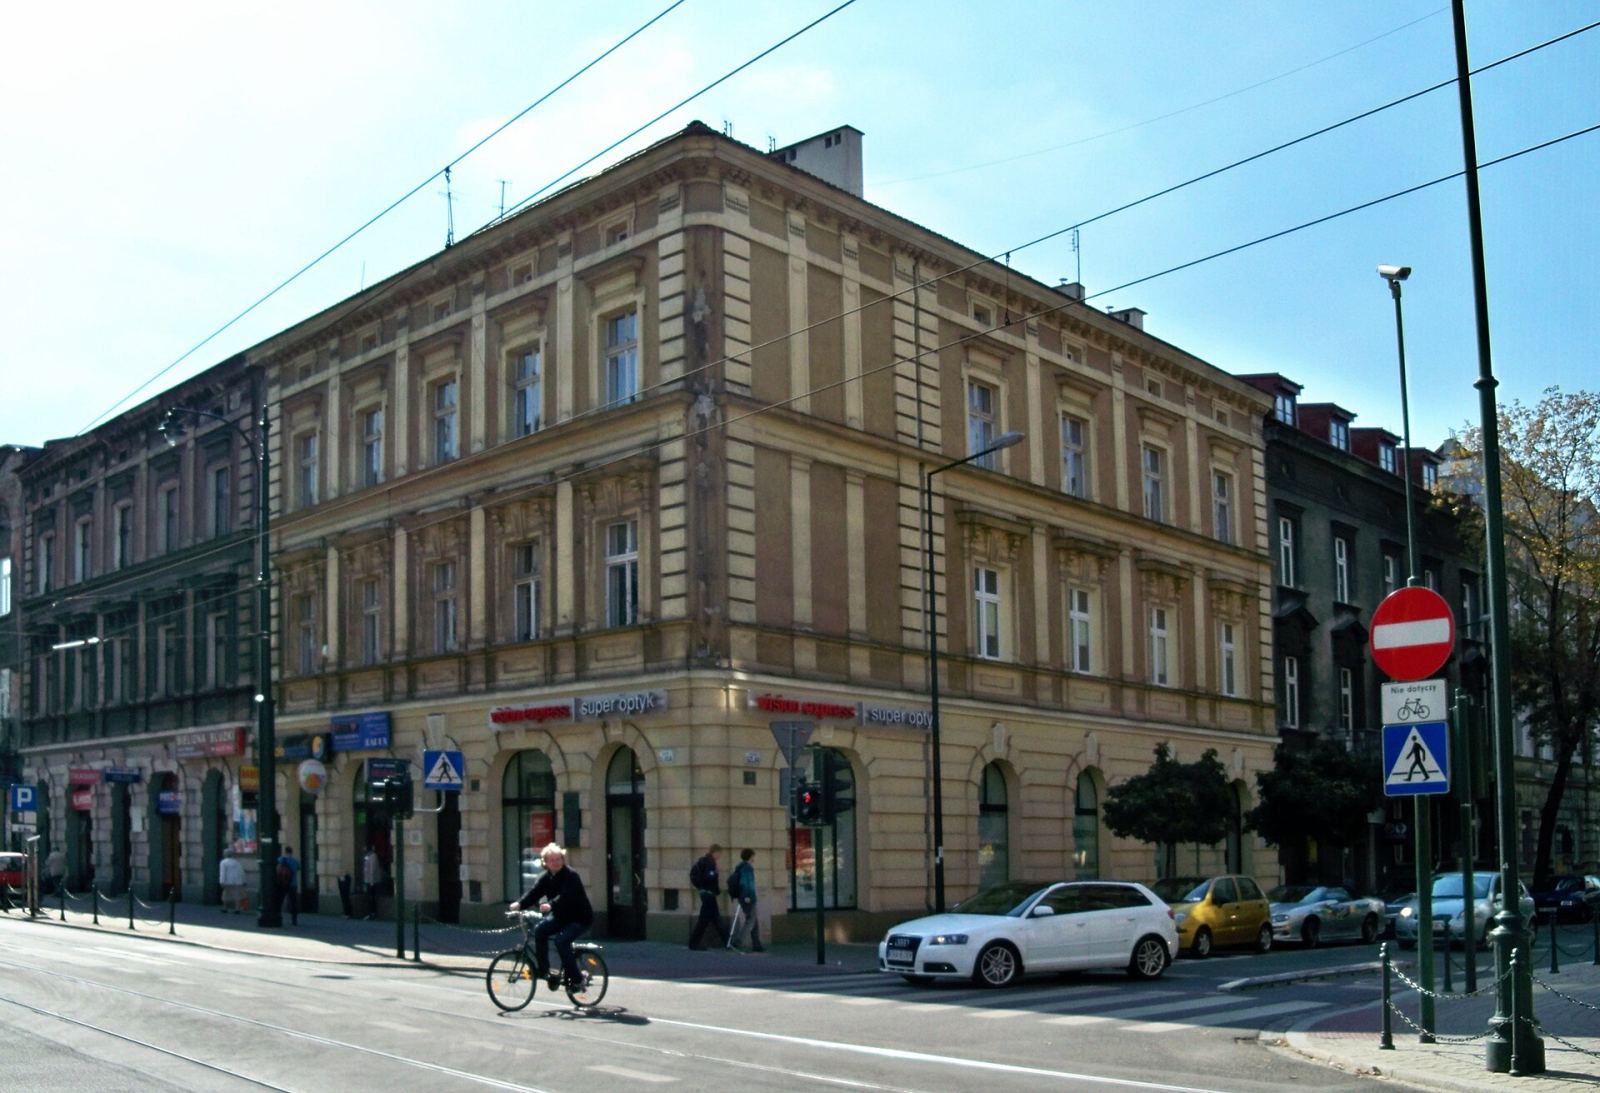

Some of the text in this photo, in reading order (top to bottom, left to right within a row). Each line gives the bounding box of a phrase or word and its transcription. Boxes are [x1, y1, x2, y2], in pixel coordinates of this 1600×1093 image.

[1407, 685, 1436, 694] dotyczy
[580, 693, 655, 716] super optyk
[871, 707, 933, 727] super opty
[17, 787, 32, 808] P
